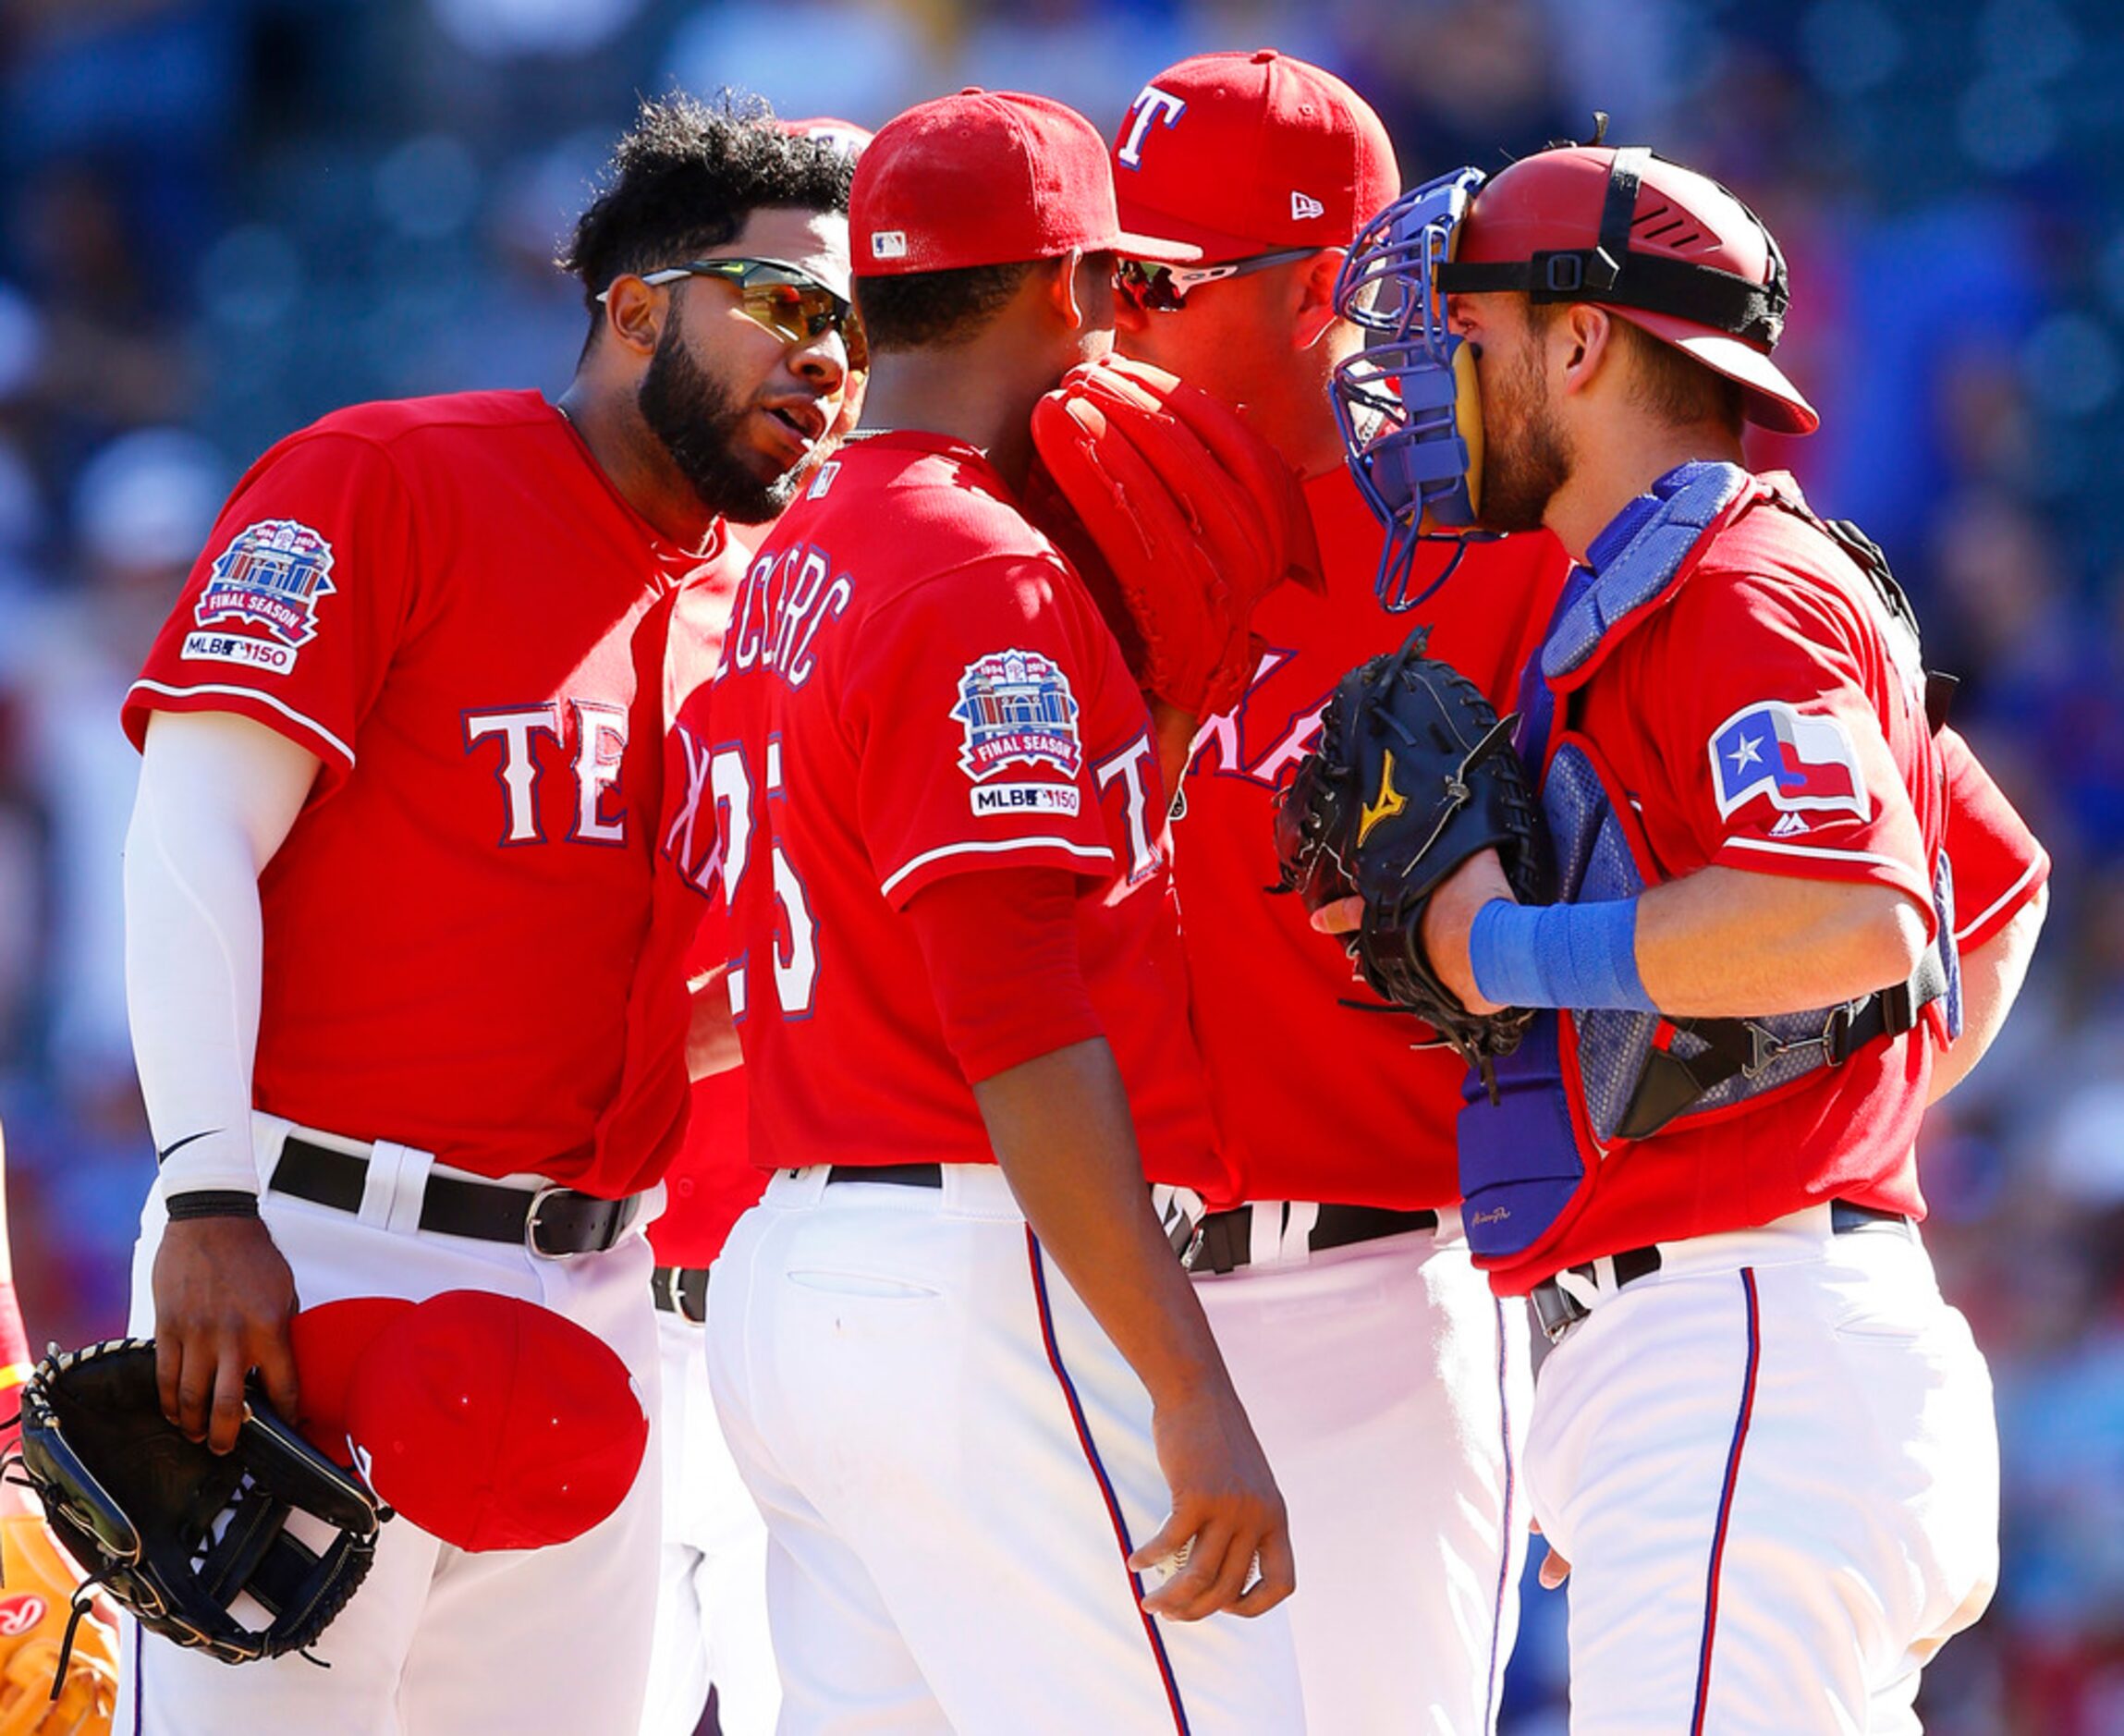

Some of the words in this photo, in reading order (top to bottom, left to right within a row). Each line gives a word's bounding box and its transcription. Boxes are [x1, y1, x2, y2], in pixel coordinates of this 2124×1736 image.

[1117, 84, 1188, 172] T
[209, 593, 246, 610] FINAL
[248, 594, 300, 630] SEASON
[186, 636, 225, 654] MLB
[251, 643, 287, 666] 150
[976, 737, 1021, 763] FINAL
[1022, 735, 1072, 760] SEASON
[977, 789, 1025, 810] MLB
[1054, 790, 1078, 810] 150
